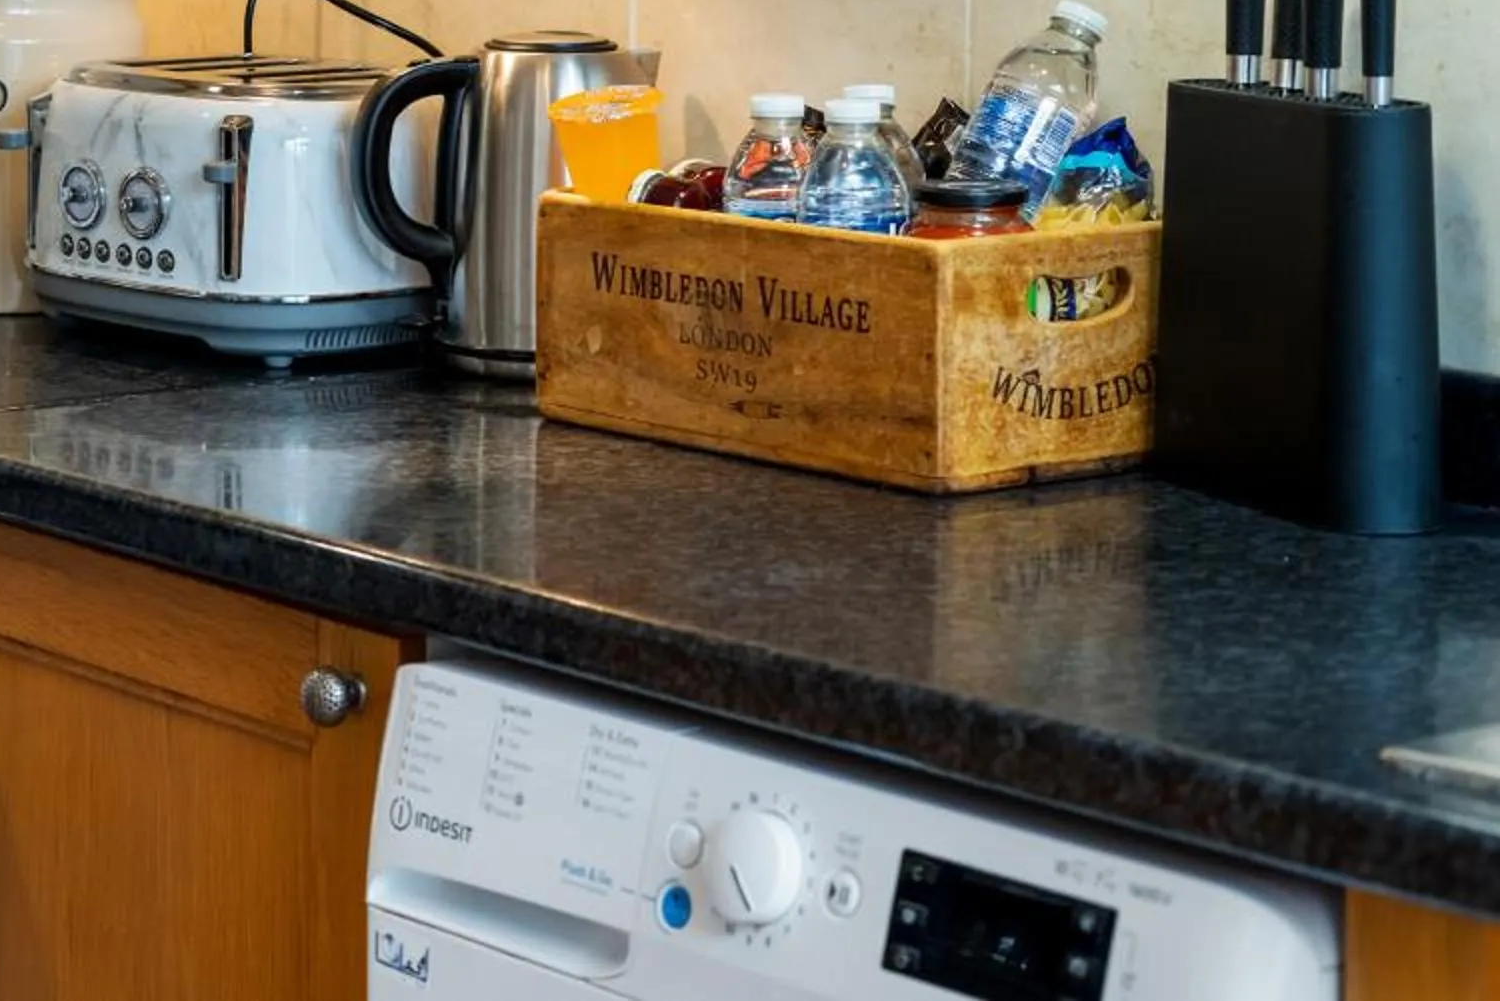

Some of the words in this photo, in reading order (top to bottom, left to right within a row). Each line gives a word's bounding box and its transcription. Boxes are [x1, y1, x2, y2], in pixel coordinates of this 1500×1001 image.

[591, 251, 744, 313] WIMBLEDON
[756, 275, 872, 335] VILLAGE
[678, 322, 774, 358] LONDON
[695, 358, 759, 394] SW19
[993, 355, 1159, 420] WIMBLEDO
